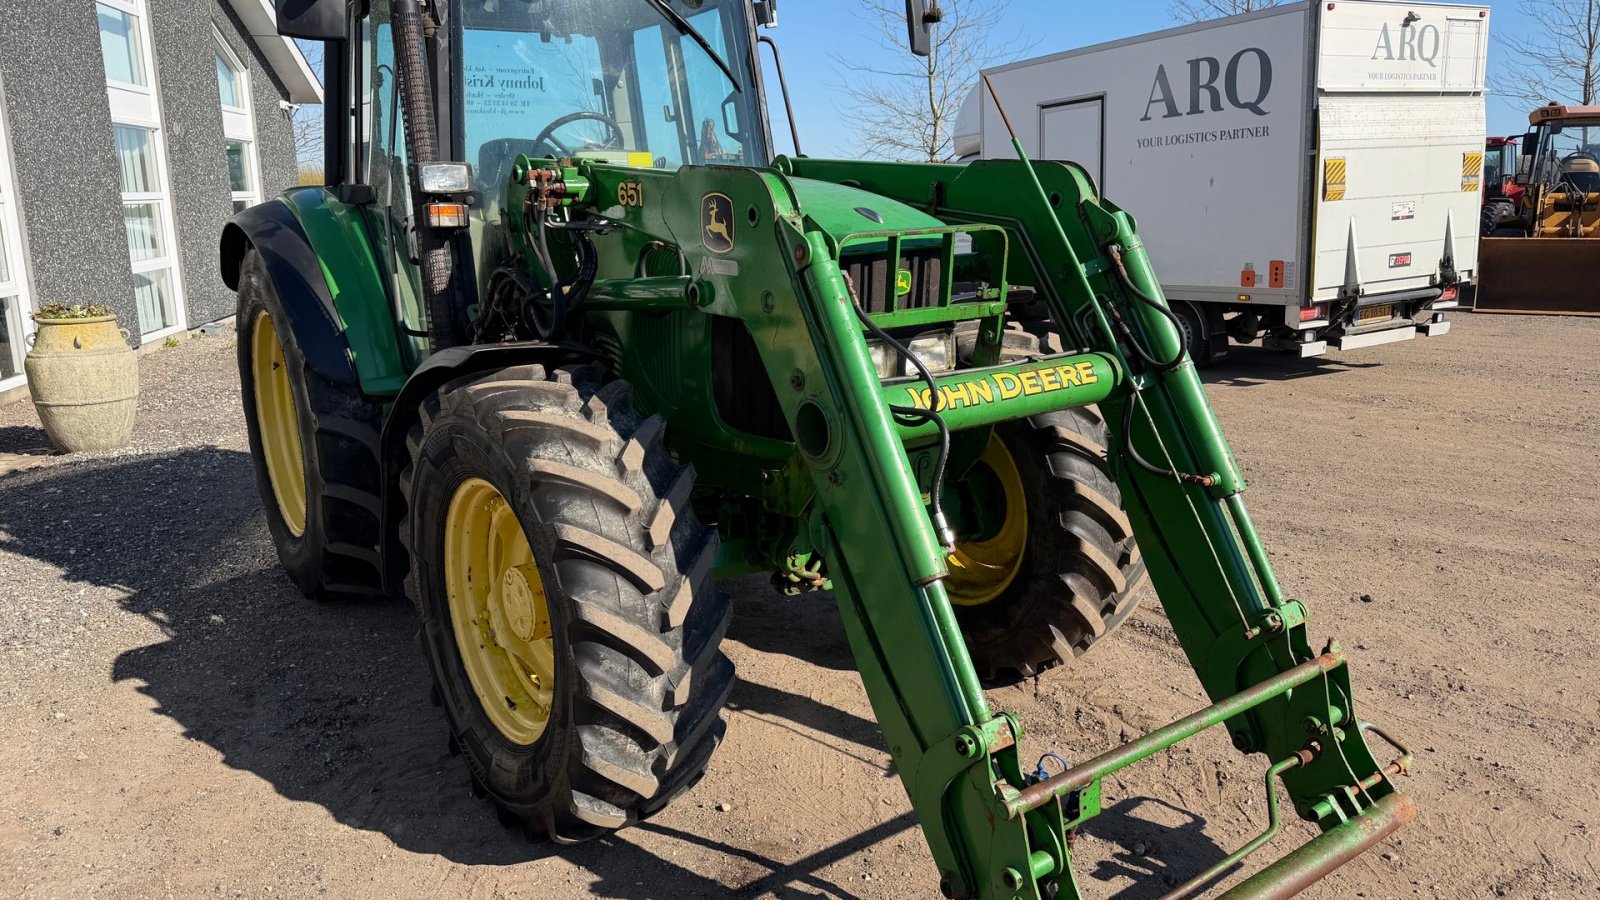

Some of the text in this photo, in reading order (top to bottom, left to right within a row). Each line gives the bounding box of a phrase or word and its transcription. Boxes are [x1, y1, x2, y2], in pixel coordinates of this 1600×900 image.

[1370, 22, 1440, 67] ARQ
[1140, 47, 1272, 121] ARQ
[1368, 72, 1437, 81] YOUR LOGISTICS PARTNER
[1137, 126, 1270, 149] YOUR LOGISTICS PARTNER
[617, 181, 643, 207] 651
[905, 361, 1099, 418] JOHN DEERE
